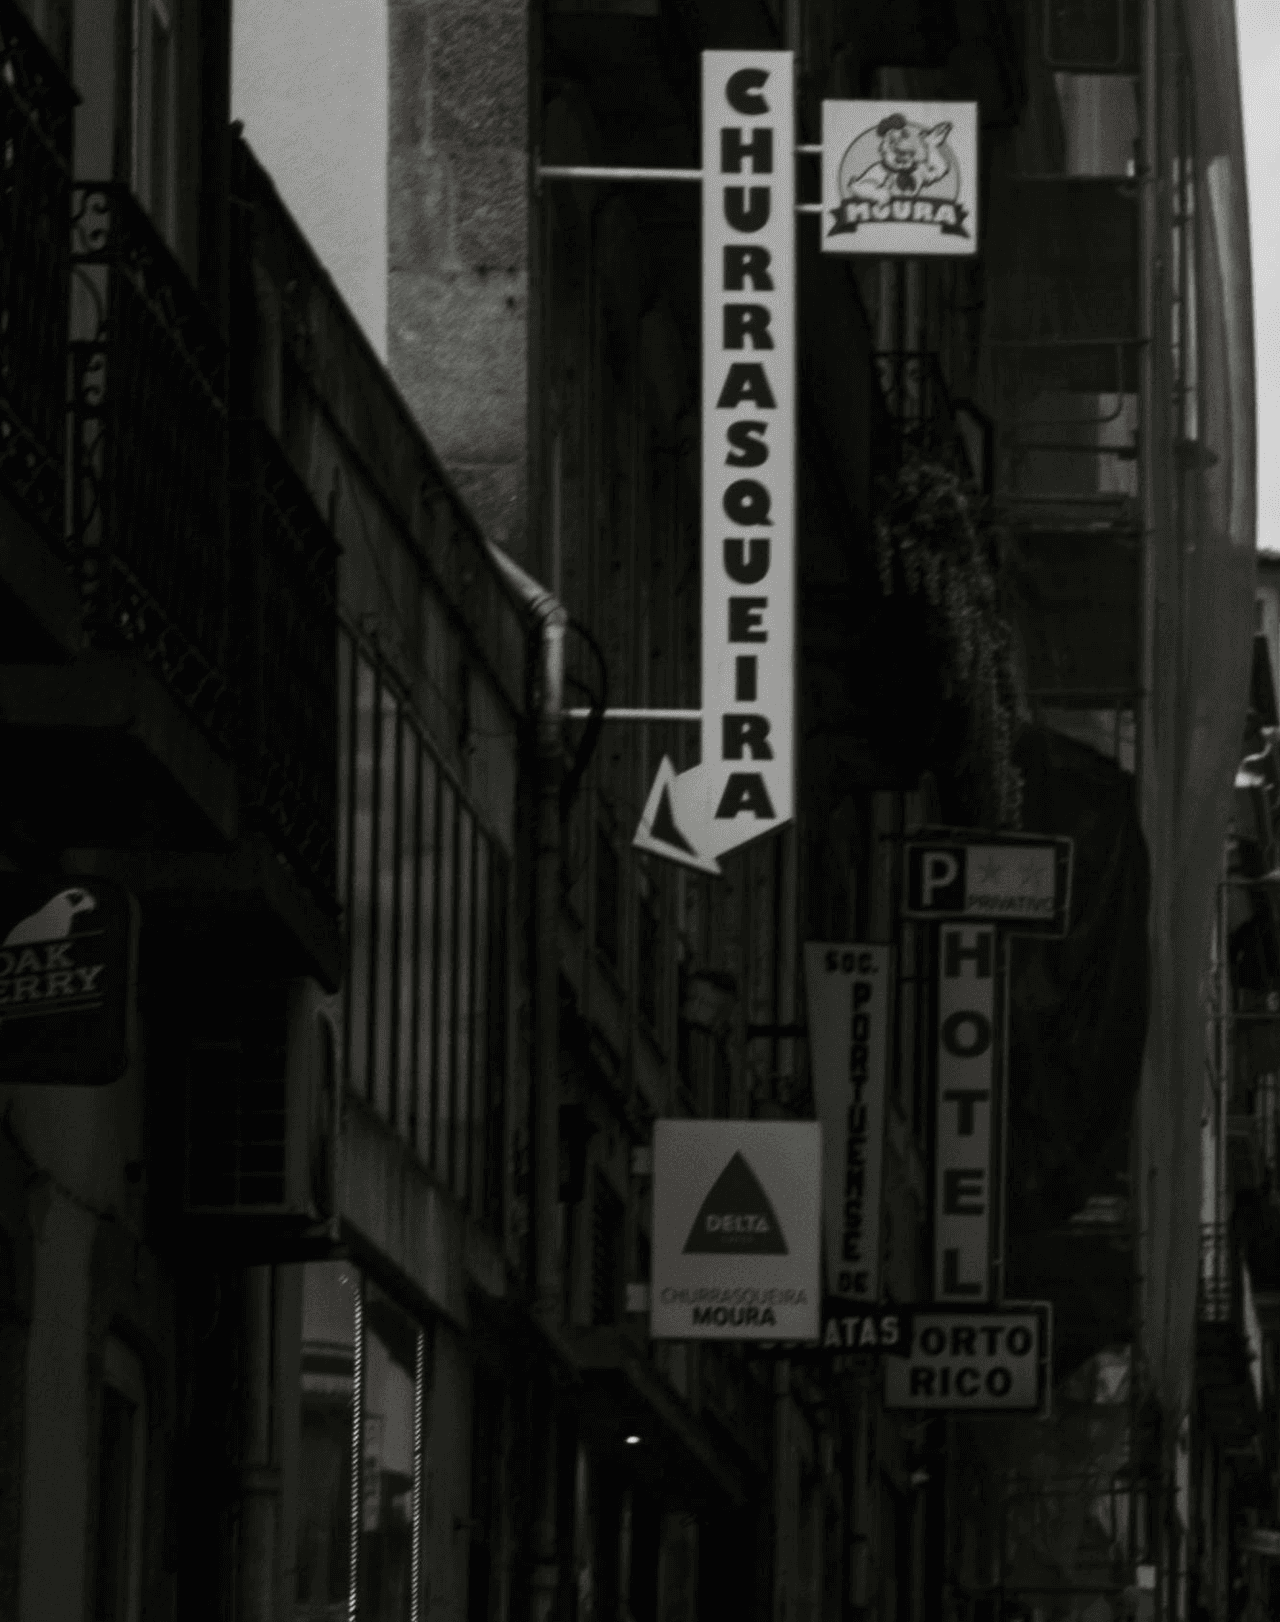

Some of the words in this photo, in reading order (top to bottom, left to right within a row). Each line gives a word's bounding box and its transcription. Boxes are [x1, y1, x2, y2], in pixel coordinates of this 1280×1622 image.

[846, 199, 957, 223] MOURA
[716, 67, 777, 819] CHURRASQUEIRA
[921, 850, 960, 907] P
[942, 931, 992, 1294] HOTEL
[705, 1214, 770, 1233] DELTA
[692, 1305, 777, 1327] MOURA
[920, 1325, 1034, 1356] ORTO
[909, 1366, 1012, 1396] RICO
